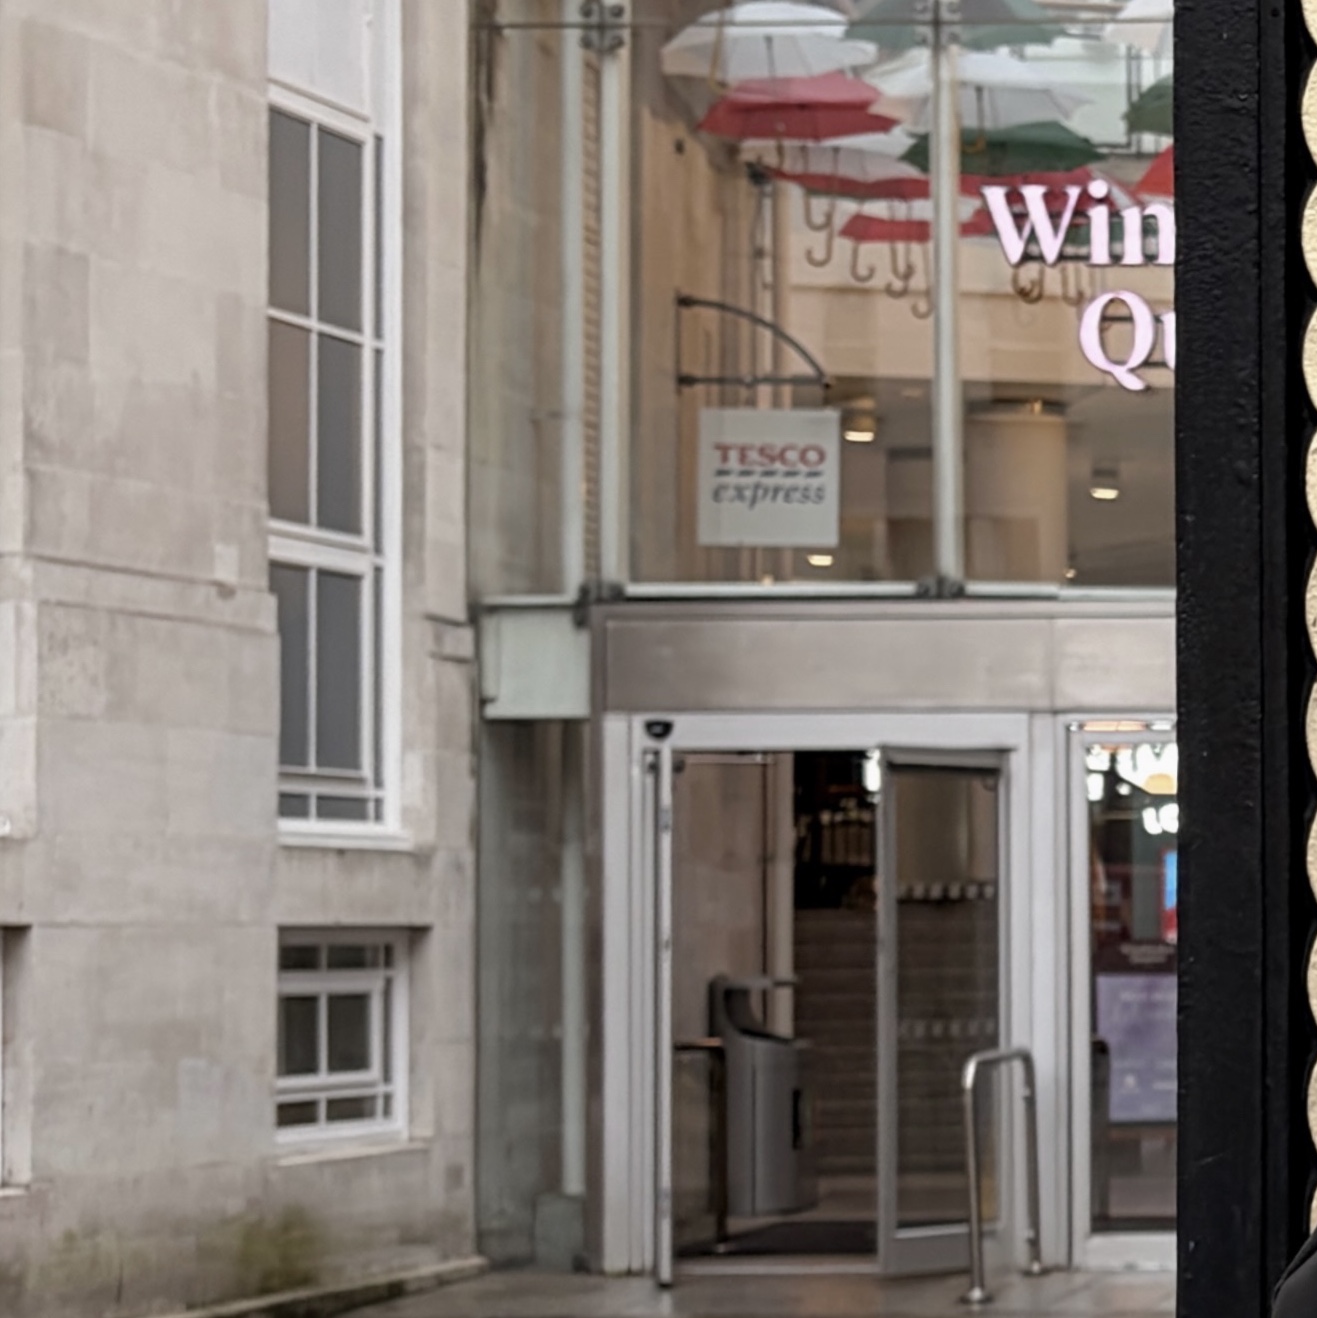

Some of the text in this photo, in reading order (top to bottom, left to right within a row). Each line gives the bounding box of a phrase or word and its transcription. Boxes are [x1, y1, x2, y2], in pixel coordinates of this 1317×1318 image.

[981, 179, 1176, 267] Win
[1080, 290, 1176, 391] Q
[713, 442, 827, 469] TESCO
[712, 482, 826, 511] express
